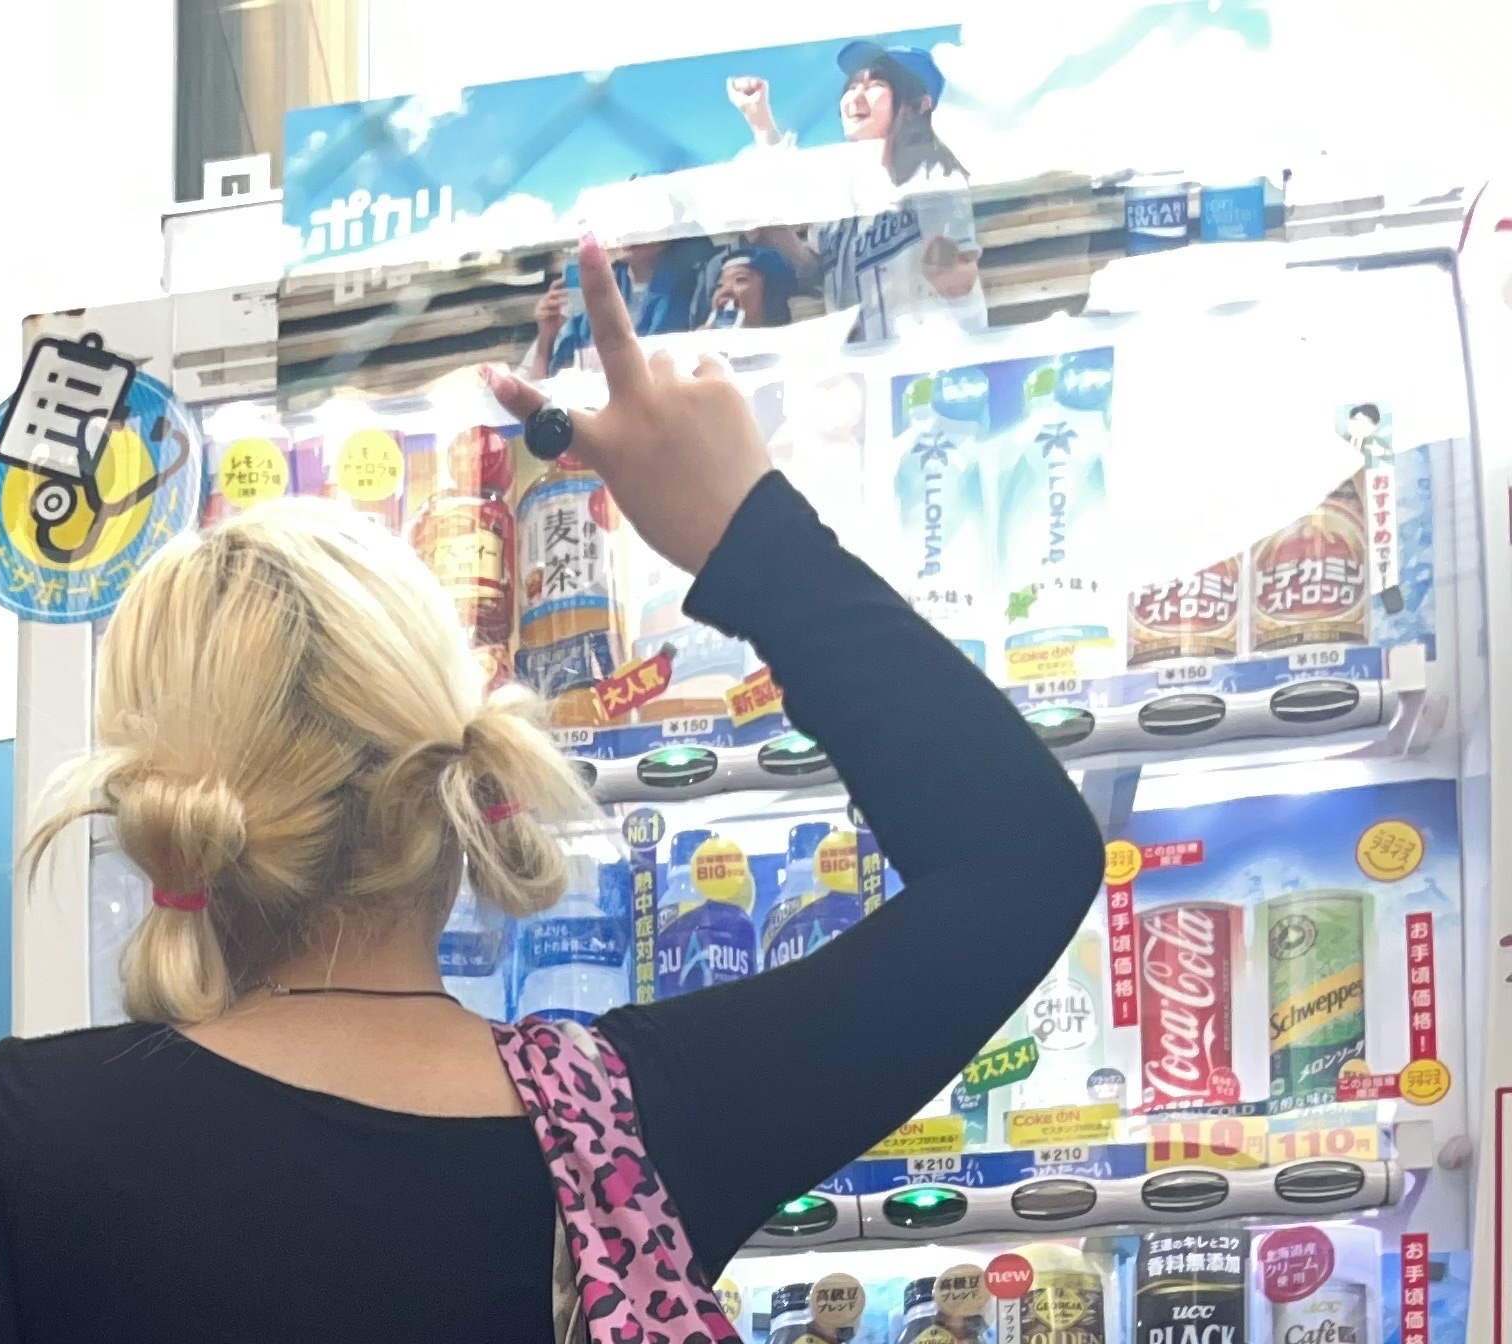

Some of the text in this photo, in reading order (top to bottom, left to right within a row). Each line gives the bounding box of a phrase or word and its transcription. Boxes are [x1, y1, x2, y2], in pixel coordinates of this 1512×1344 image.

[544, 509, 582, 594] 麦茶
[1256, 557, 1364, 595] ドデカミン
[1267, 585, 1355, 613] ストロング
[1145, 598, 1231, 622] ストロング
[1296, 651, 1339, 665] ¥150
[1165, 666, 1207, 680] ¥150
[605, 664, 665, 708] 大人気
[1035, 680, 1076, 693] ¥140
[669, 719, 709, 732] ¥150
[697, 865, 727, 880] BIG
[1109, 891, 1133, 1019] お手頃価格!
[1410, 922, 1432, 1053] お手頃価格!
[1034, 999, 1091, 1019] CHILL
[1144, 907, 1215, 1102] Coca-Cola
[1269, 978, 1365, 1040] Schweppes
[965, 1044, 1036, 1082] オススメ!
[1298, 1040, 1365, 1082] メロンソーダ
[1041, 1147, 1082, 1161] ¥210
[914, 1158, 955, 1171] ¥210
[1150, 1236, 1239, 1253] 王道のキレとコク
[988, 1267, 1030, 1283] new
[1148, 1254, 1241, 1277] 香料無添加
[1265, 1259, 1319, 1278] クリーム
[939, 1274, 980, 1291] 高級豆
[818, 1301, 855, 1314] ブレンド
